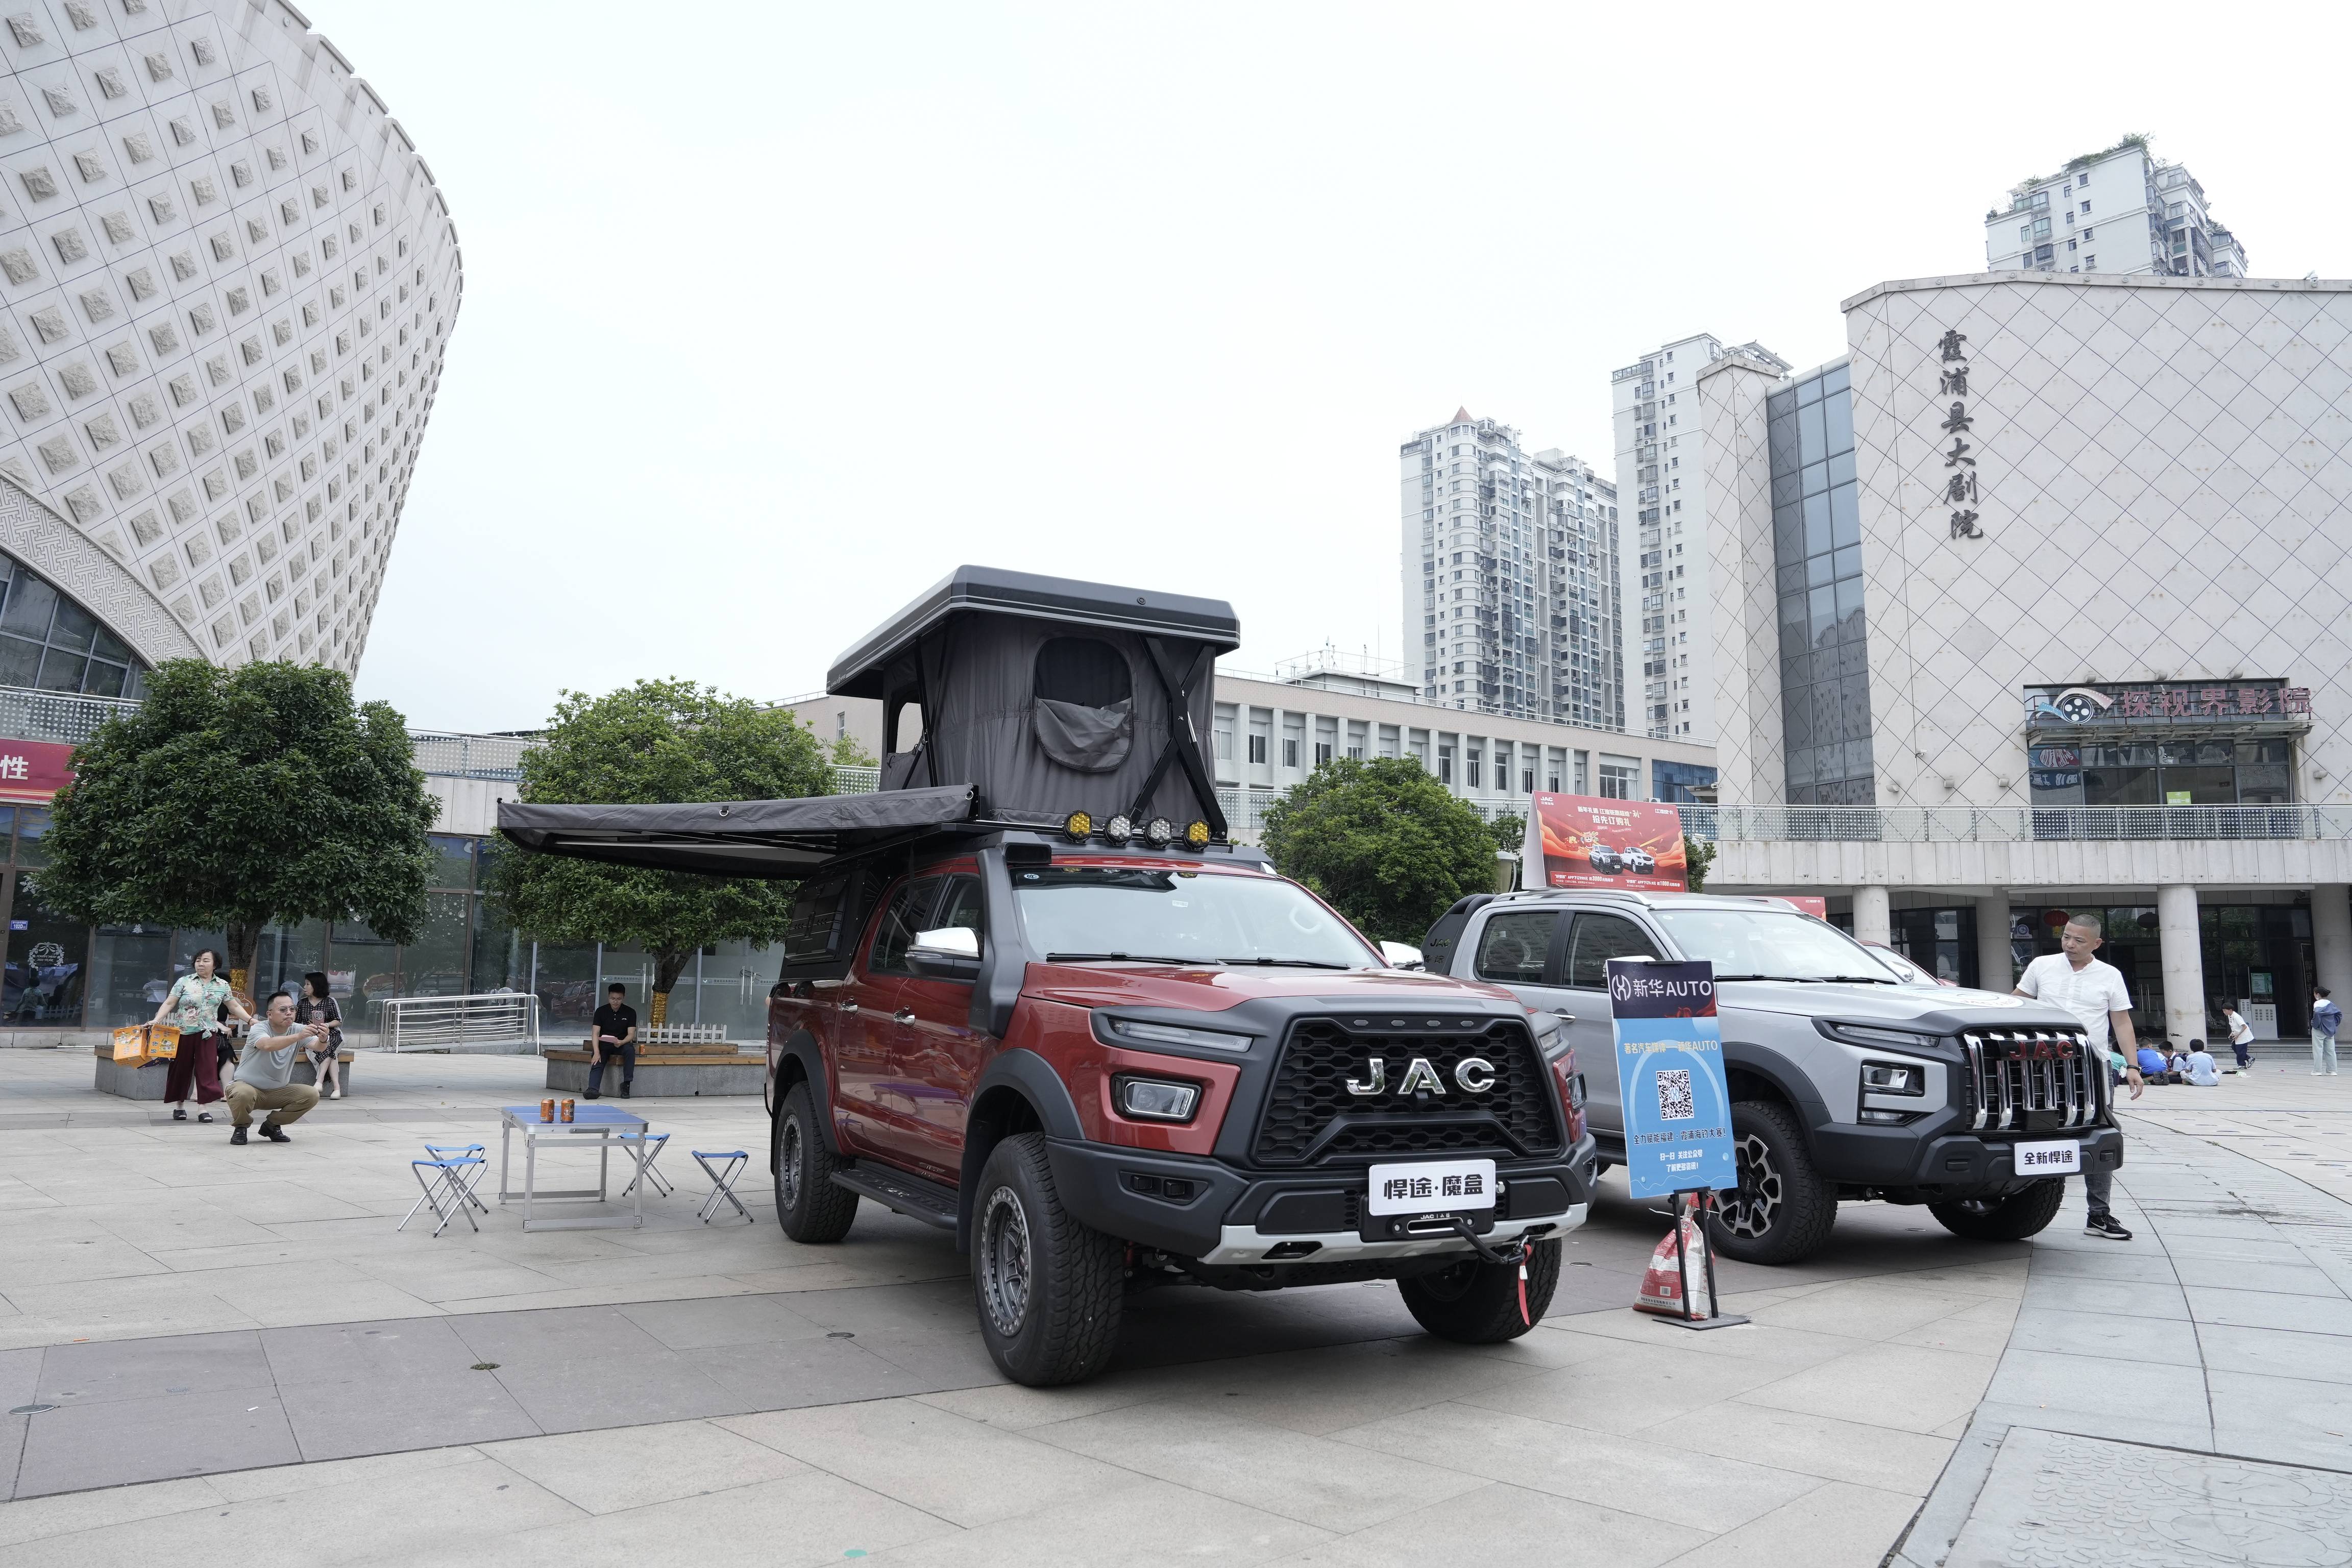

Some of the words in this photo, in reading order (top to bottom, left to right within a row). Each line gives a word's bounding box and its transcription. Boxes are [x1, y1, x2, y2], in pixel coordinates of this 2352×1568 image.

[1939, 330, 1983, 539] 霞浦县大剧院
[2121, 687, 2313, 717] 探视界影院
[1592, 815, 1631, 826] 抢先订购礼
[1633, 978, 1712, 997] 新华AUTO
[2009, 1040, 2073, 1060] JAC
[1345, 1058, 1496, 1095] JAC
[1659, 1152, 1675, 1161] 扫一扫
[1678, 1149, 1703, 1160] 关注公众号
[2024, 1149, 2073, 1165] 全新悍途
[1666, 1162, 1699, 1172] 了解更多资讯！
[1383, 1173, 1483, 1200] 悍途·魔盒
